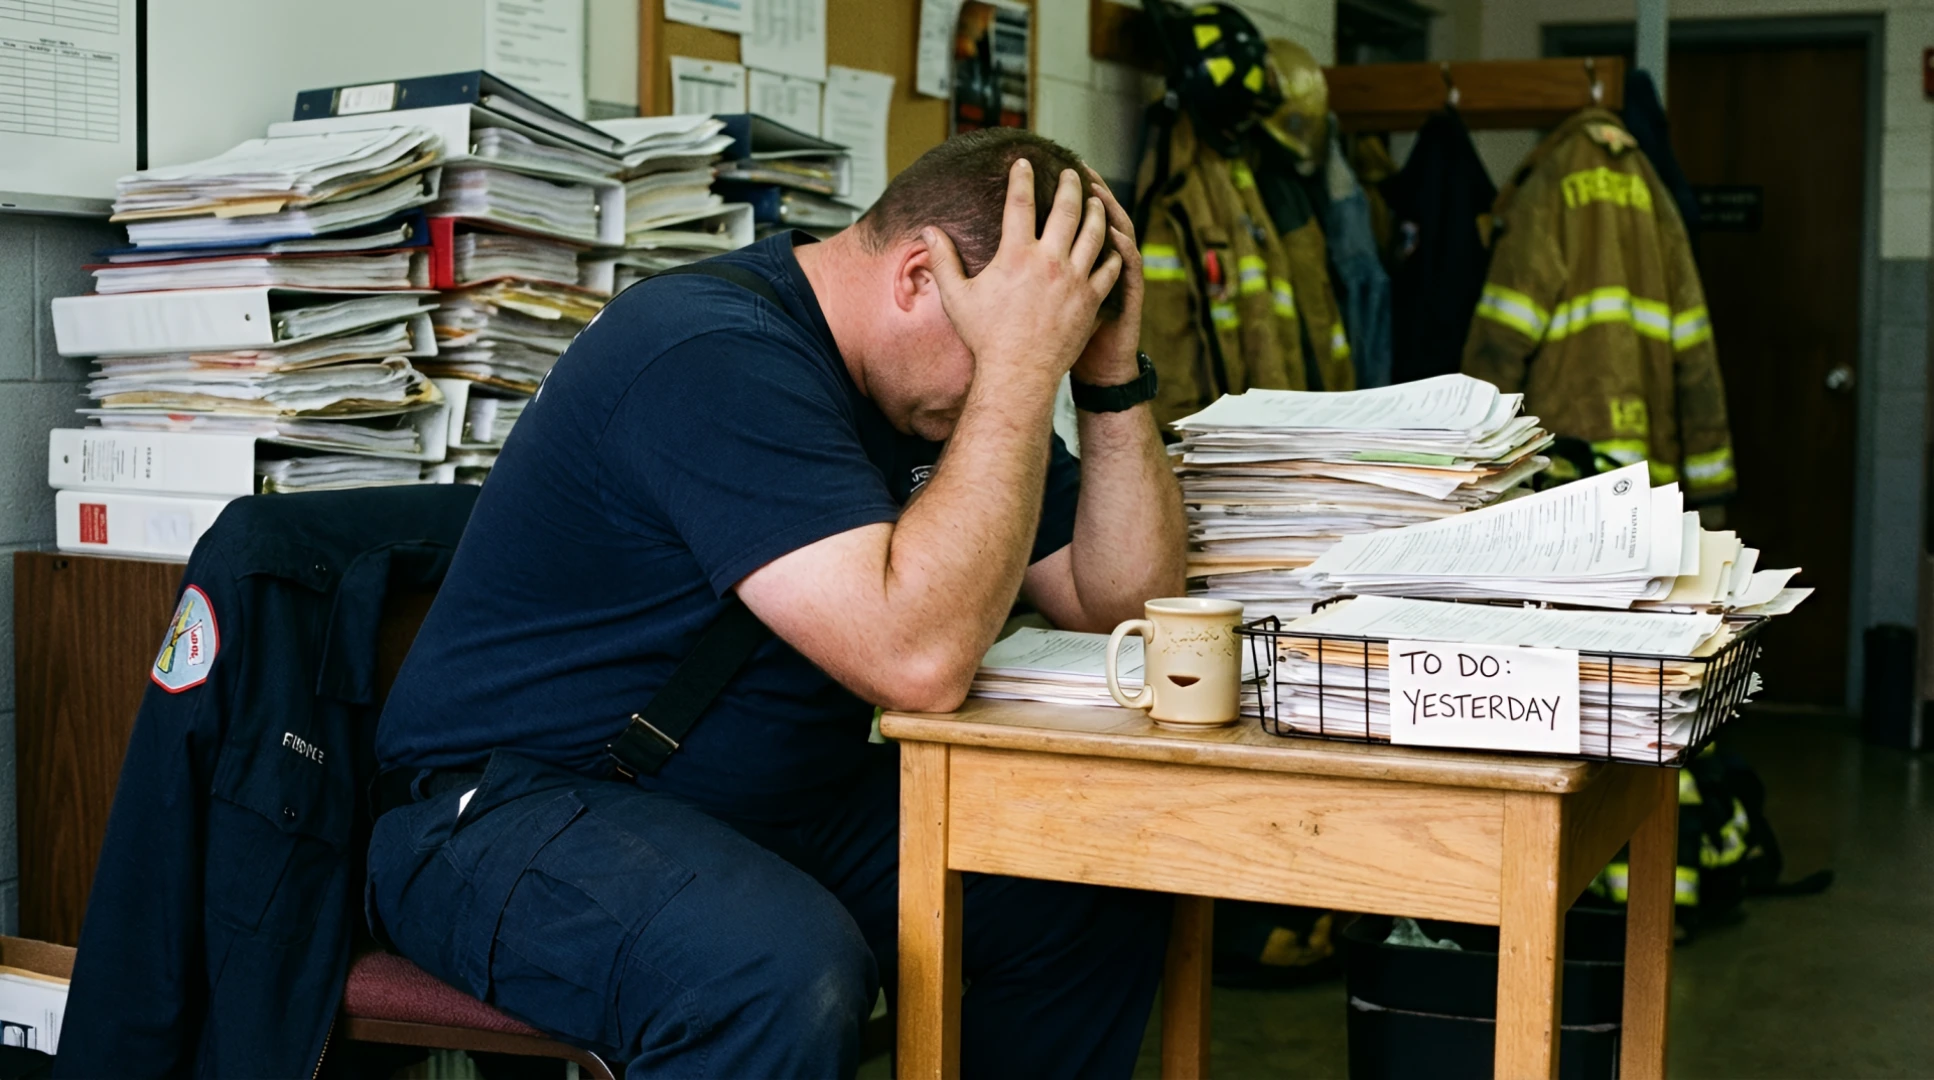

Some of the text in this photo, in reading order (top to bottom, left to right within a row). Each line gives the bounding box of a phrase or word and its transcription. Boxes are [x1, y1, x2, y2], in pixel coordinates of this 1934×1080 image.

[1400, 651, 1511, 678] TO DO:
[1402, 688, 1561, 731] YESTERDAY
